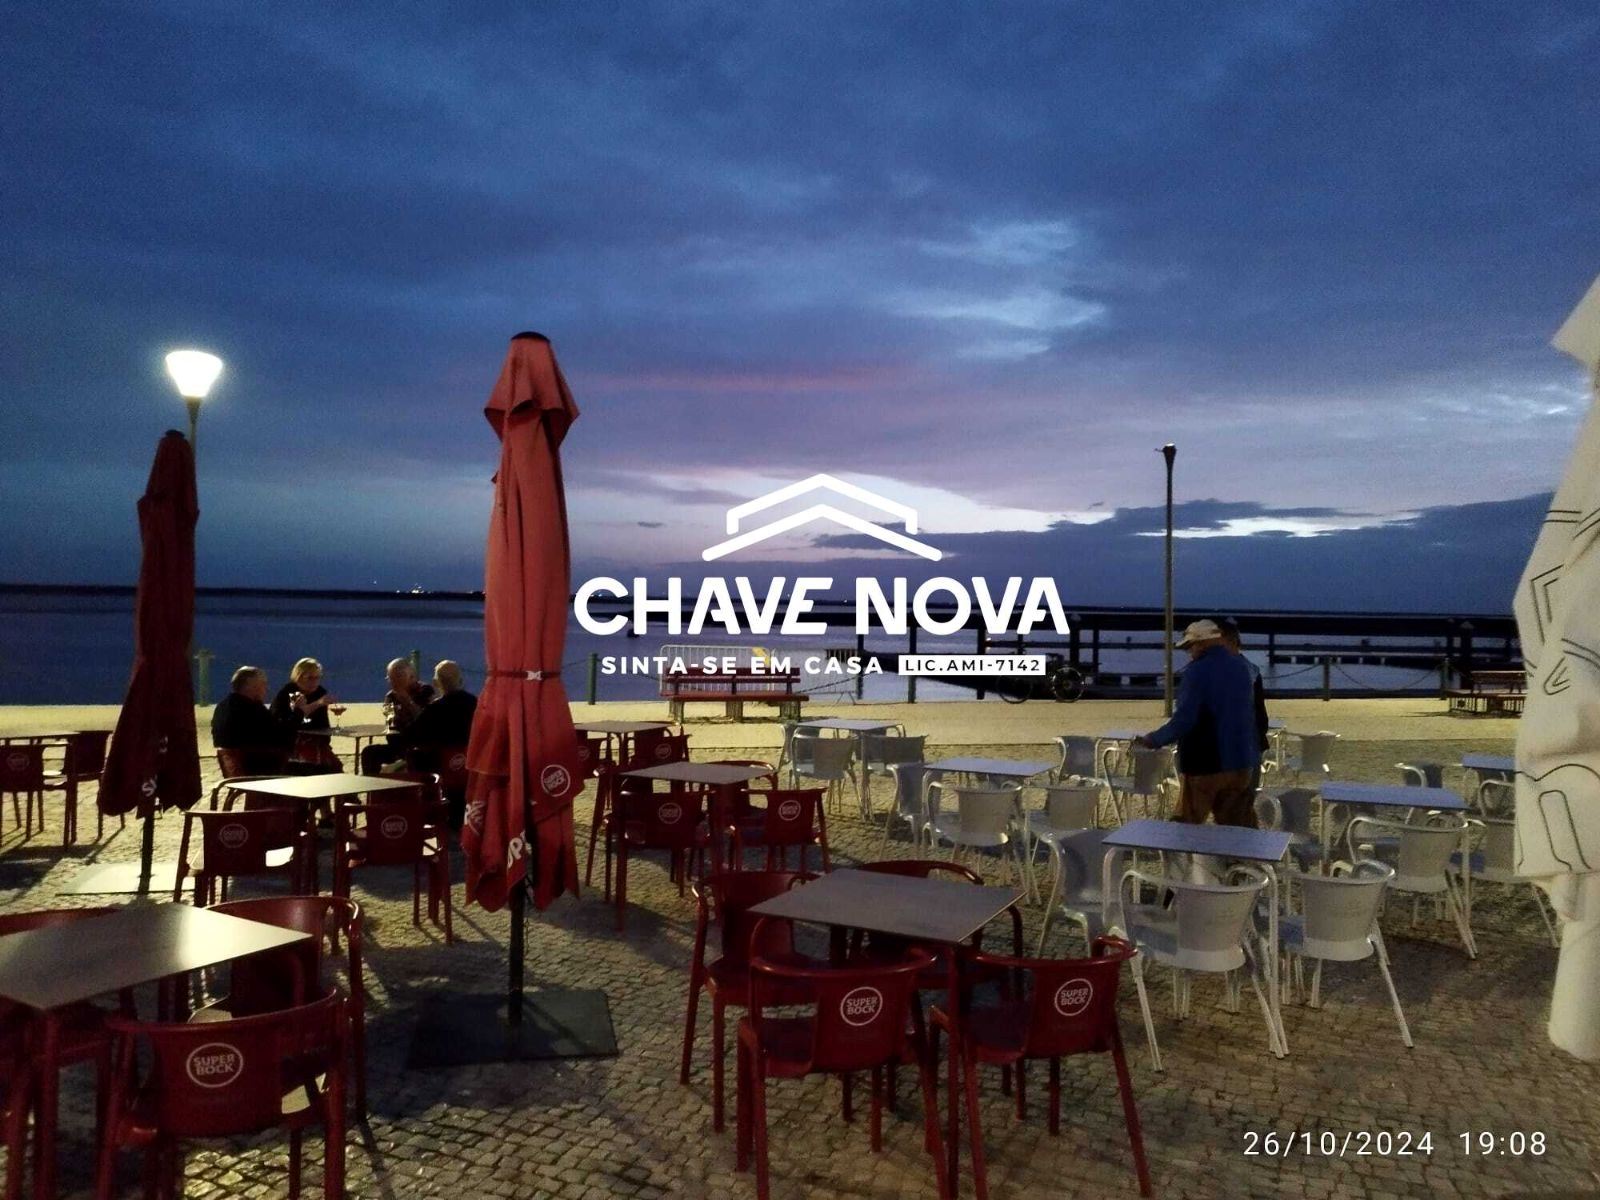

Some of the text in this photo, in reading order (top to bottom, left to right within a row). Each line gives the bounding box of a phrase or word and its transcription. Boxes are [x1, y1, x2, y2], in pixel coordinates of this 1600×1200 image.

[1060, 988, 1089, 998] SUPER
[845, 996, 878, 1006] SUPER
[1061, 995, 1086, 1006] BOCK
[846, 1004, 875, 1015] BOCK
[193, 1053, 235, 1066] SUPER
[195, 1064, 234, 1076] BOCK
